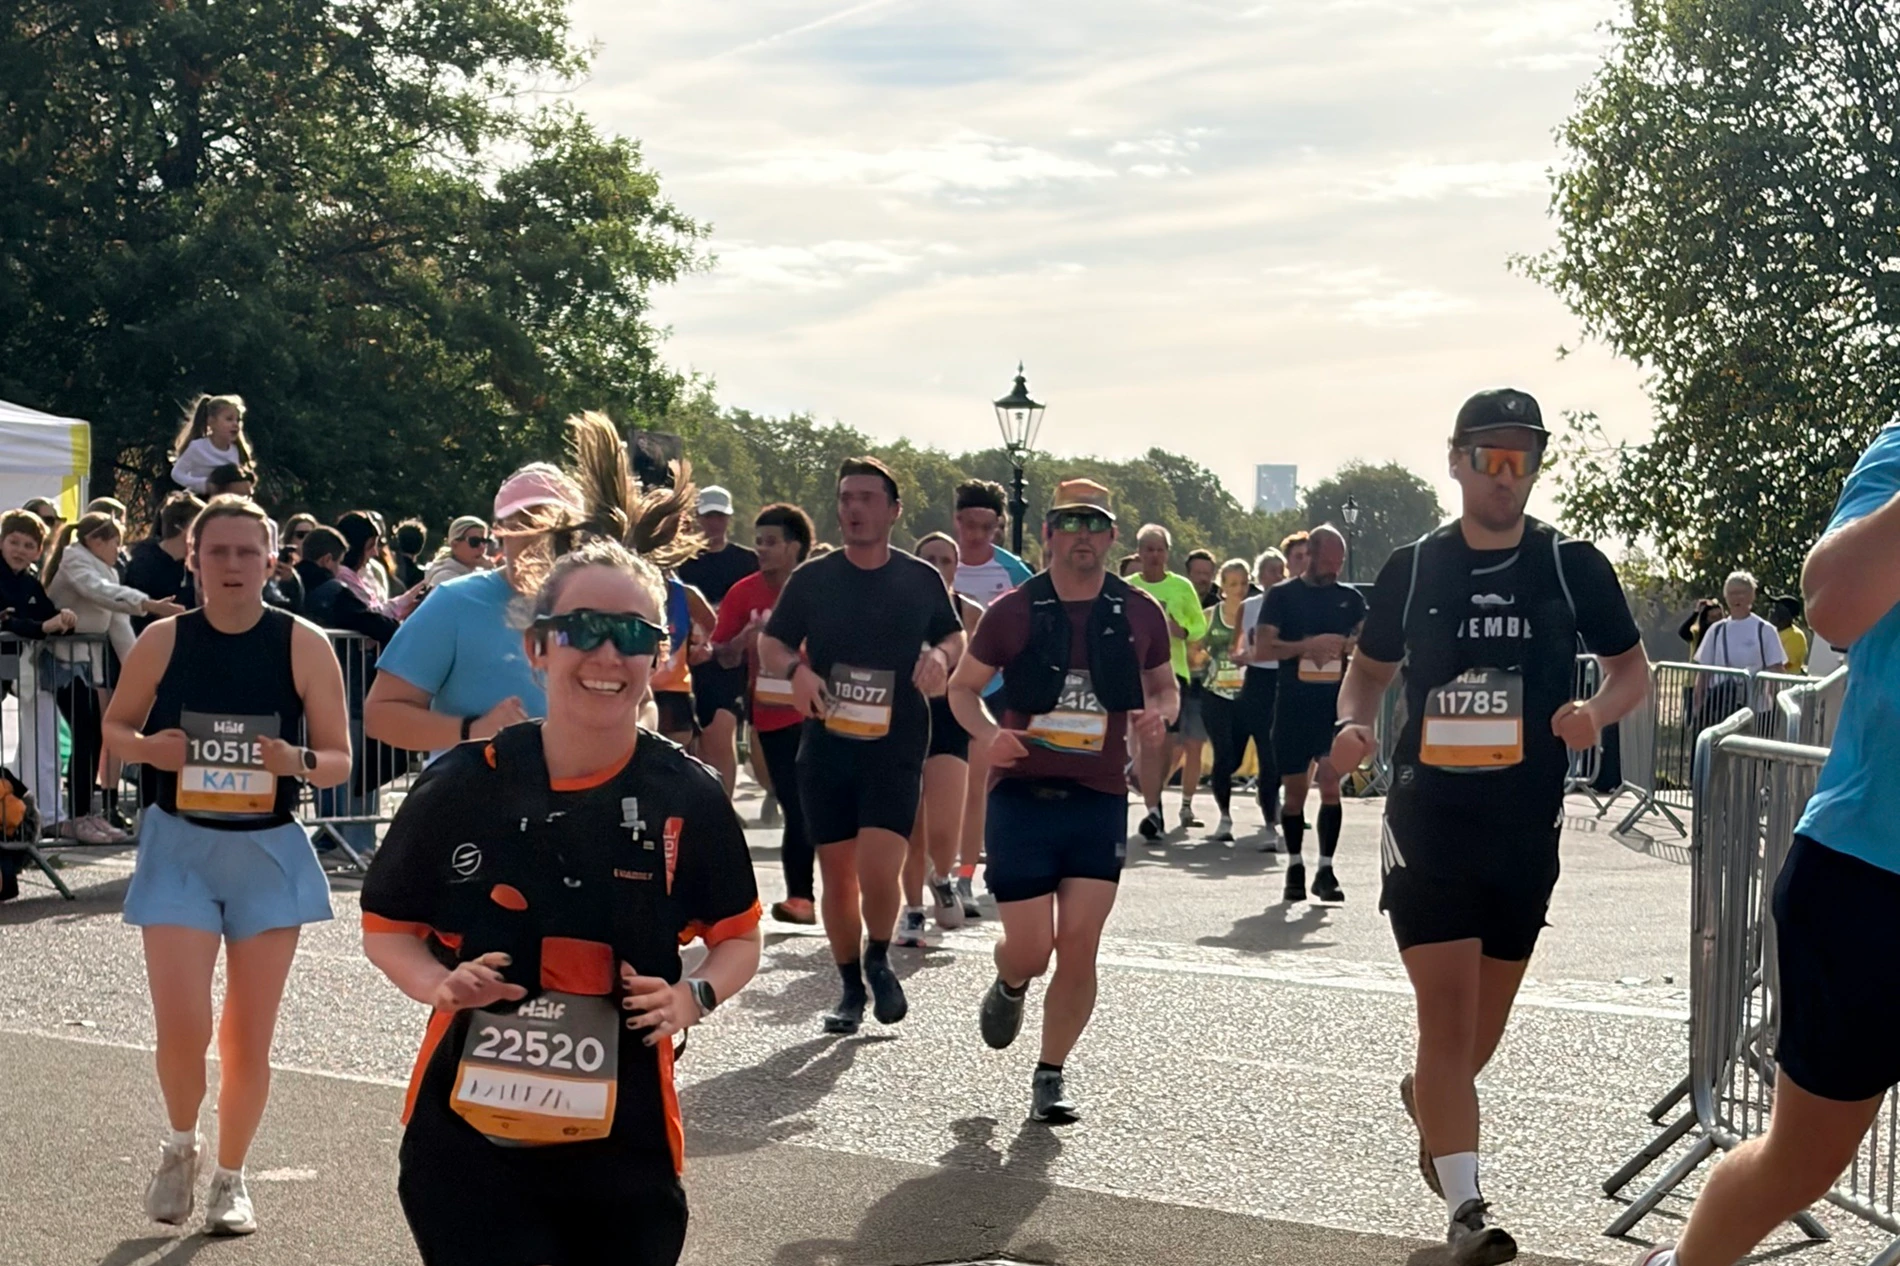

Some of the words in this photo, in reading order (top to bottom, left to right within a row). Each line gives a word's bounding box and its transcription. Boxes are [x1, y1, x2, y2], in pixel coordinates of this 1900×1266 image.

[835, 681, 887, 704] 18077
[1437, 691, 1508, 714] 11785
[190, 739, 264, 765] 10515
[203, 769, 253, 791] KAT
[518, 998, 566, 1020] Half
[472, 1026, 605, 1072] 22520
